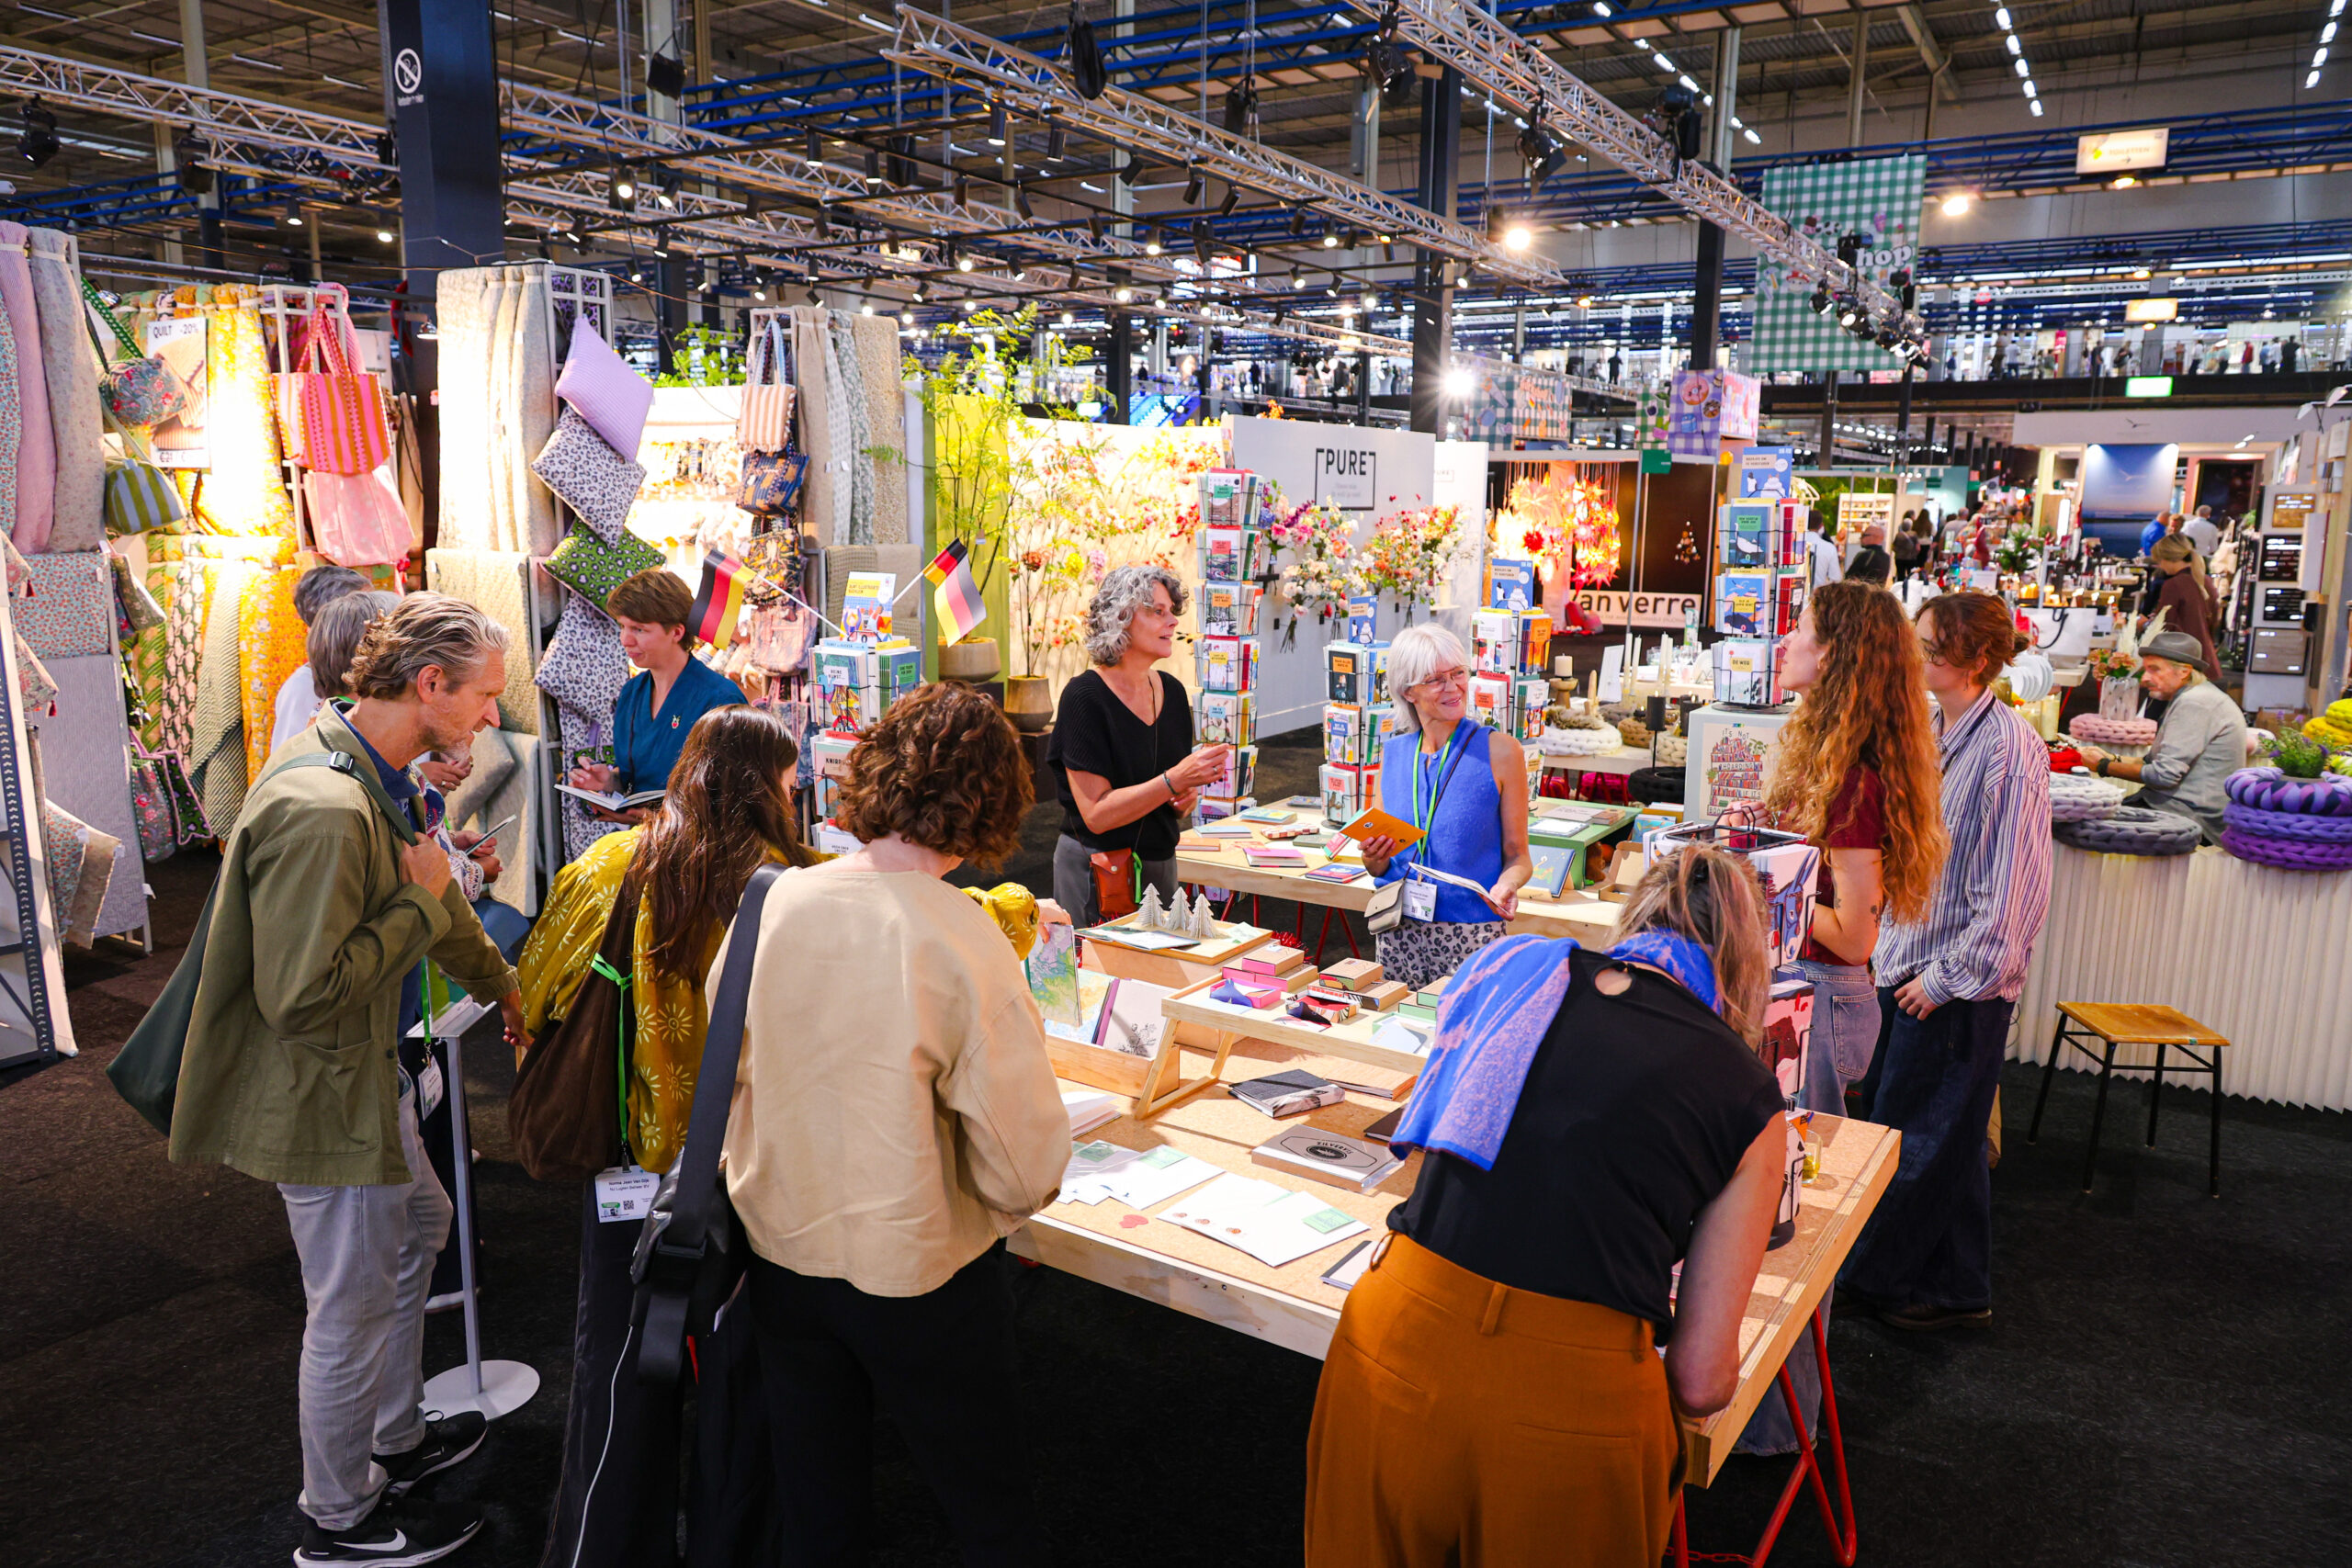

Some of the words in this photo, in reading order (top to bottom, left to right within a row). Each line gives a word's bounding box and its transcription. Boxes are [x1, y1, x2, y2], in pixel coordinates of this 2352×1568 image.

[153, 325, 173, 339] QUILT
[1326, 448, 1367, 476] PURE
[1619, 595, 1696, 616] verre
[1737, 730, 1749, 740] NOT
